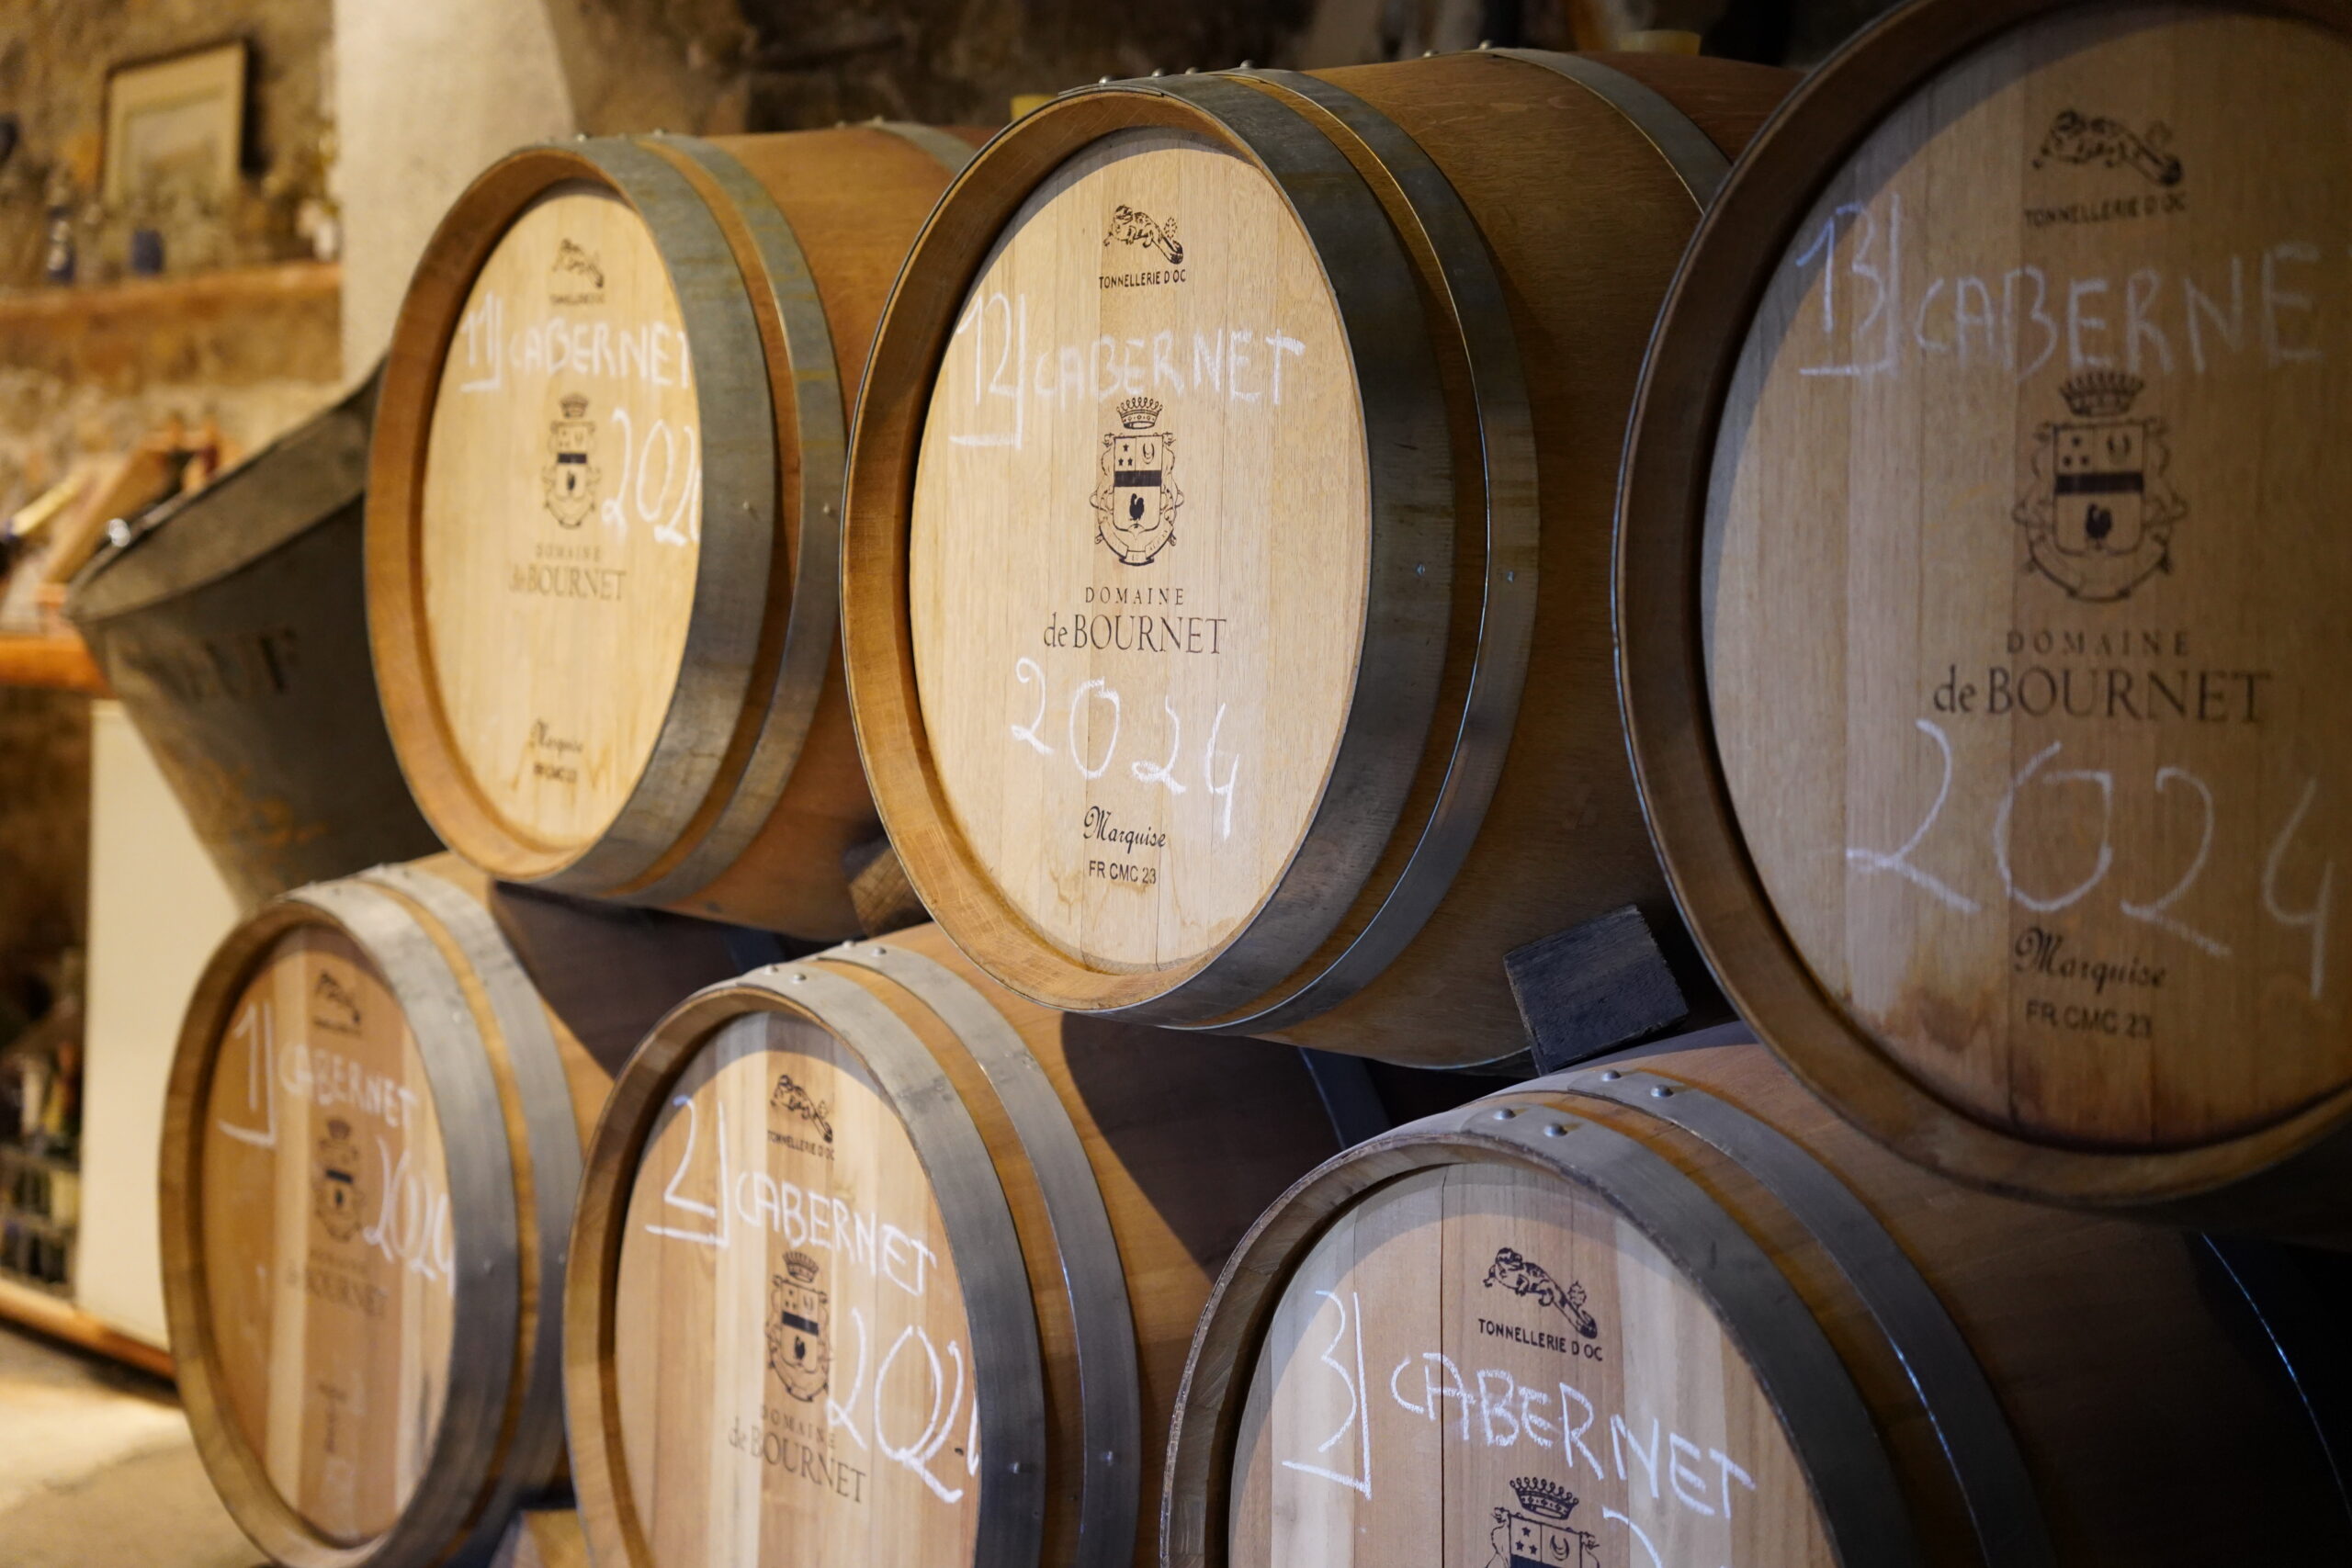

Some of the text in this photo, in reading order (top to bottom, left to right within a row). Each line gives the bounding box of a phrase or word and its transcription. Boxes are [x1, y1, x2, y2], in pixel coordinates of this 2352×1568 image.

[1099, 271, 1161, 289] TONNELLERIE
[1915, 241, 2352, 381] CABERNE
[1033, 329, 1306, 411] CABERNET
[1085, 587, 1184, 605] DOMAINE
[2007, 627, 2190, 656] DOMAINE
[1011, 656, 1239, 840] 2024
[1083, 806, 1166, 854] Marquise
[1845, 719, 2335, 998] 2024
[1089, 860, 1157, 885] FR CMC 23
[2015, 926, 2166, 995] Marquise
[2027, 999, 2059, 1027] FR
[2064, 1005, 2117, 1035] CMC
[735, 1170, 937, 1297] CABERNET
[1478, 1318, 1566, 1353] TONNELLERIE
[1390, 1352, 1756, 1518] CABERNET
